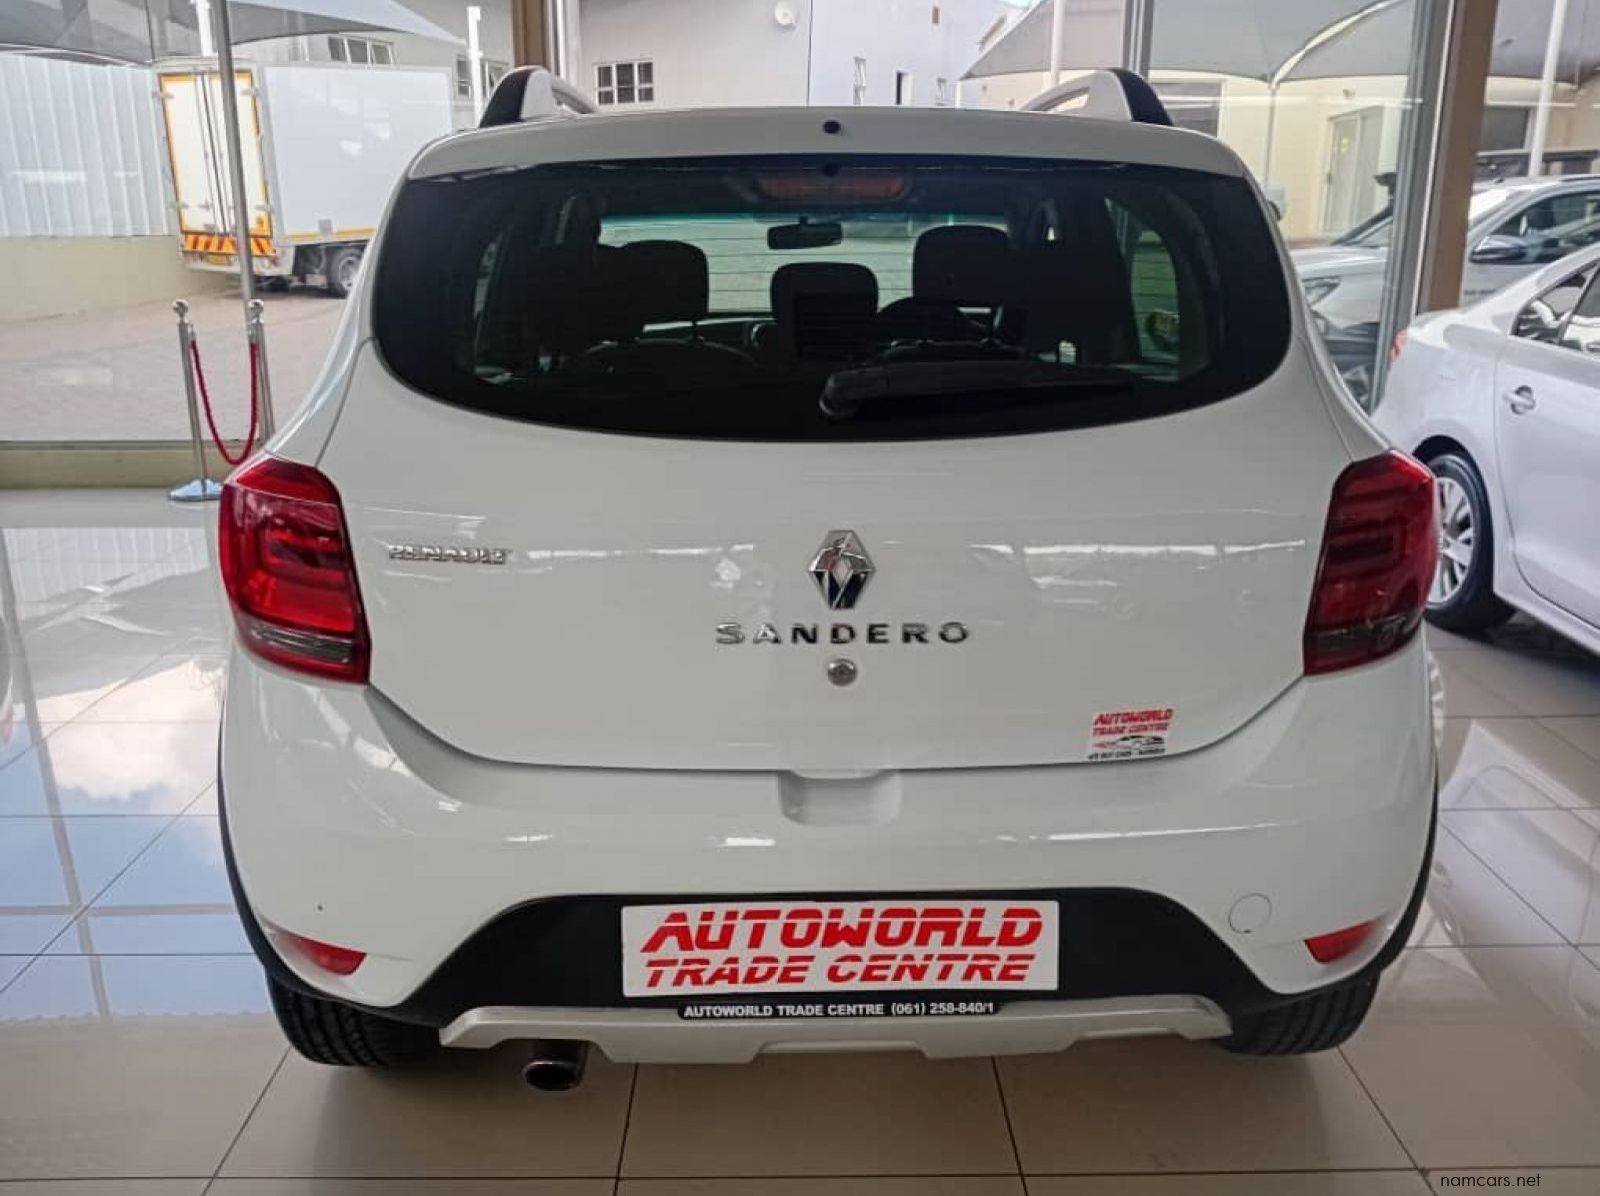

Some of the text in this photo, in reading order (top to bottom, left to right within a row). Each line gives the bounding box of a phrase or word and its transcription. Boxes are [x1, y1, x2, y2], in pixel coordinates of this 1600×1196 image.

[715, 621, 970, 645] SANDERO
[1094, 708, 1174, 725] AUTOWORLD
[640, 907, 1043, 953] AUTOWORLD
[646, 954, 1036, 988] TRADE CENTRE
[684, 1005, 772, 1017] AUTOWORLD
[777, 1004, 824, 1017] TRADE
[827, 1003, 884, 1017] CENTRE
[891, 1002, 926, 1017] (061)
